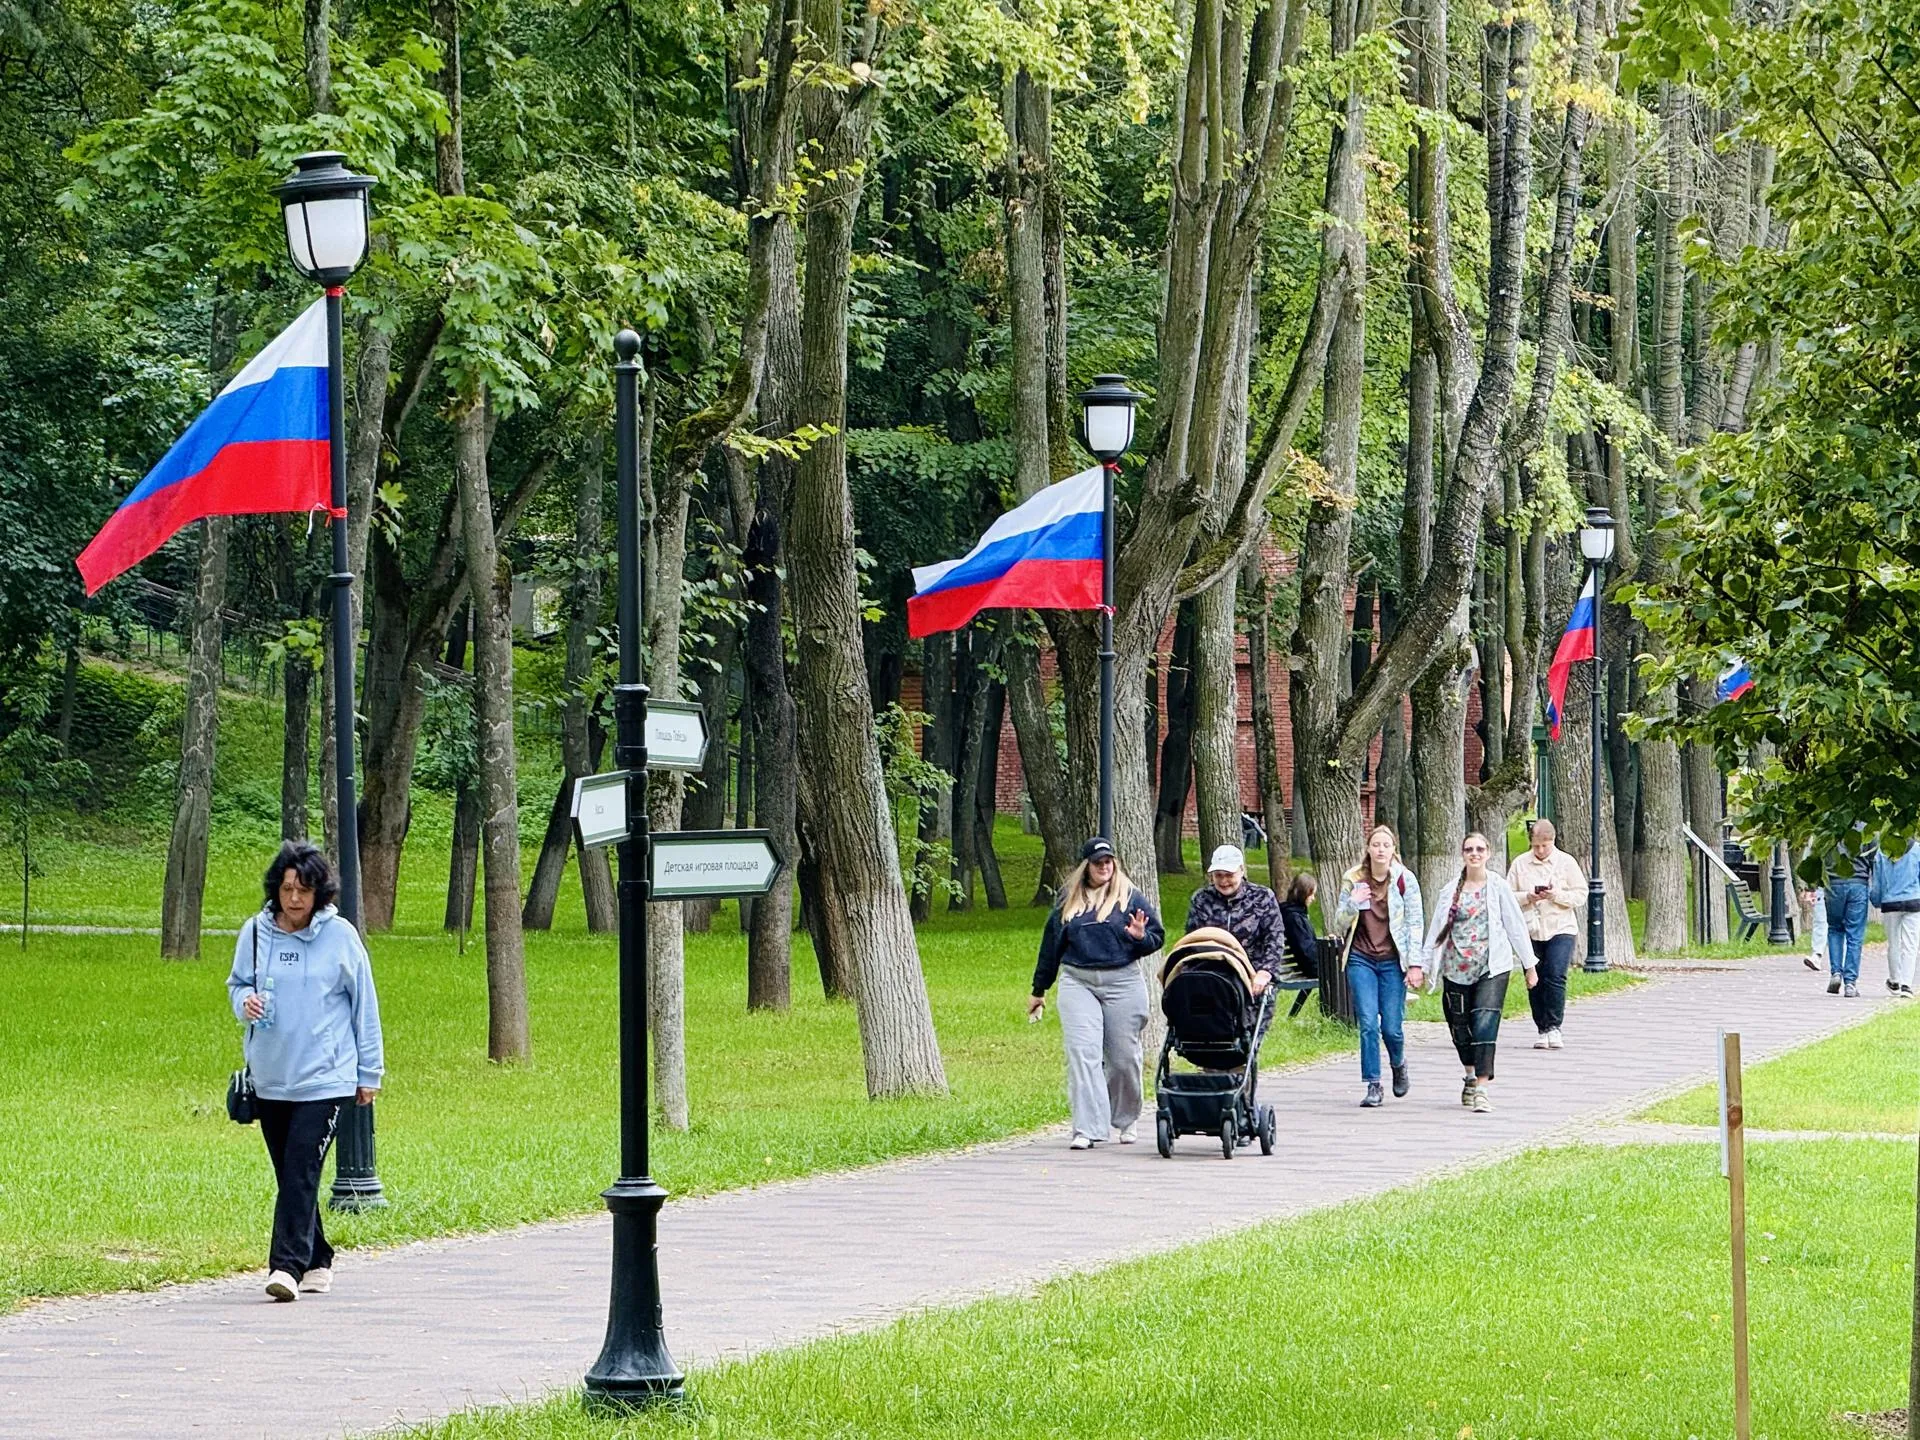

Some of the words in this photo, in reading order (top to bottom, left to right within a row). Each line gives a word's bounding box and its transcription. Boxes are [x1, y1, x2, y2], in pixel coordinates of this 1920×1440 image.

[664, 861, 694, 876] Детская
[695, 862, 723, 875] игровая
[724, 861, 759, 872] площадка
